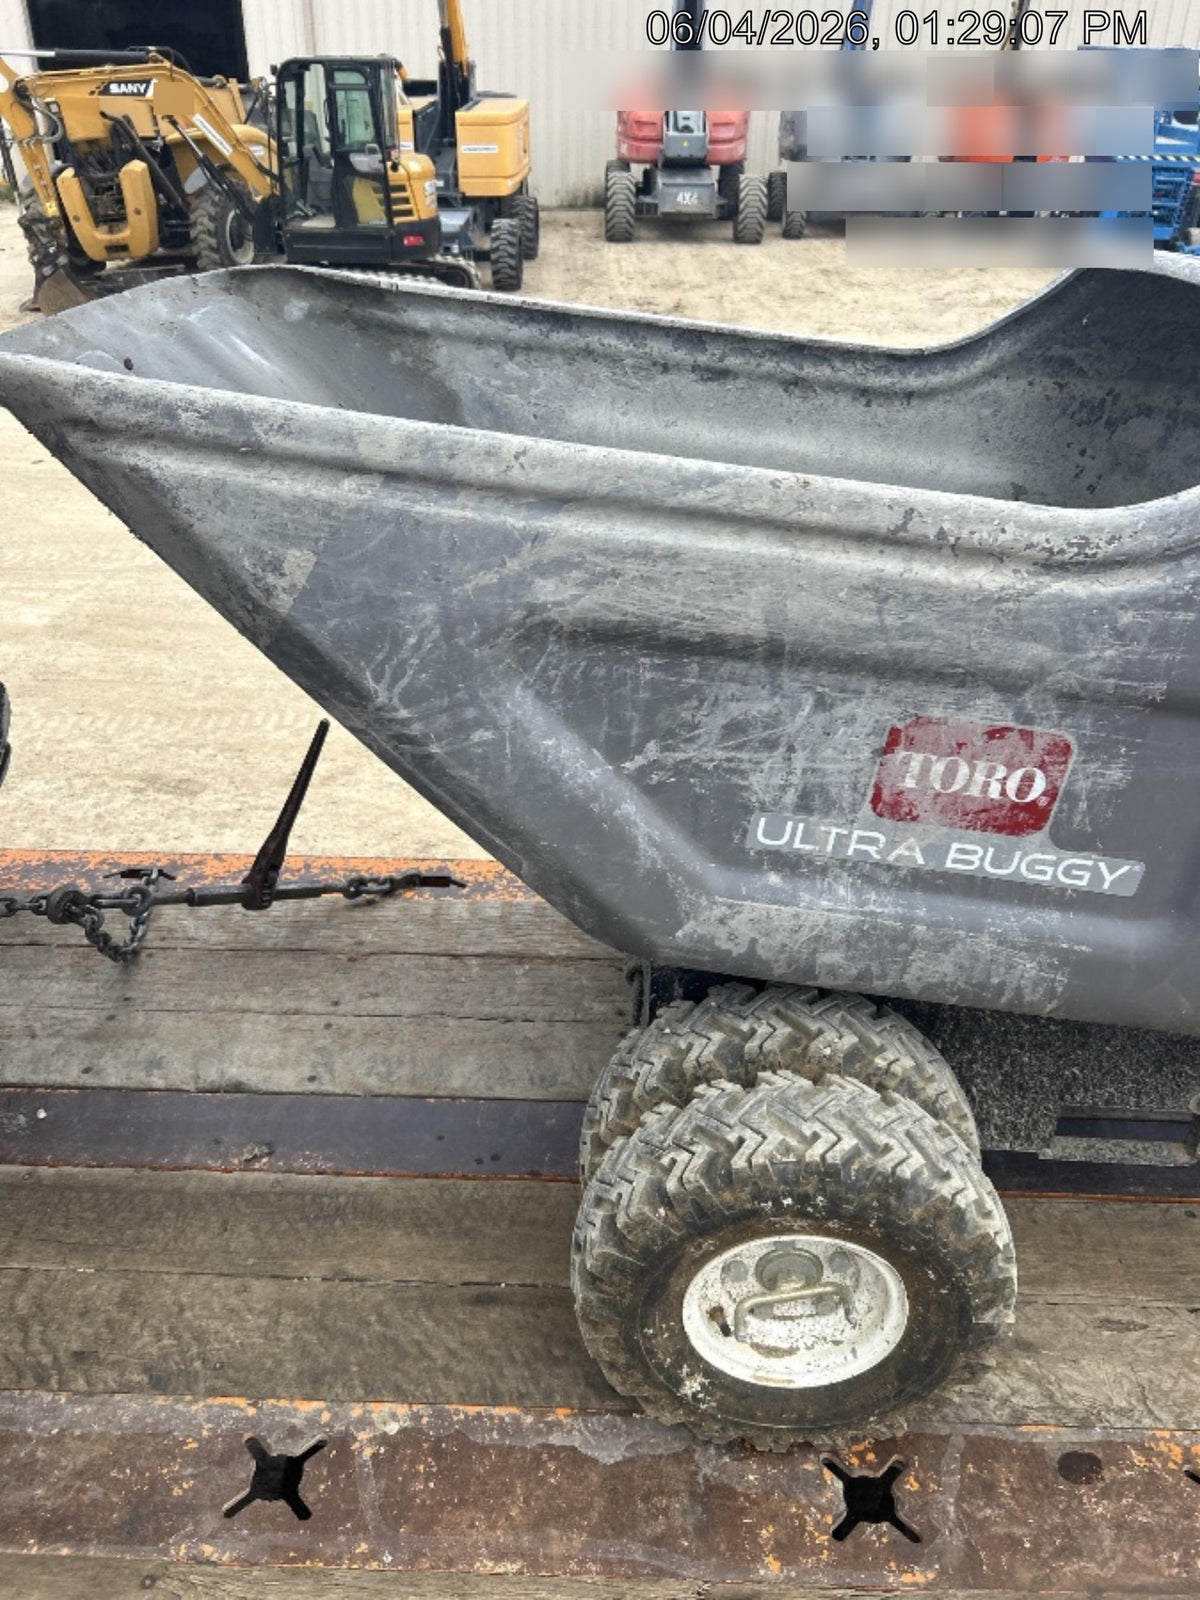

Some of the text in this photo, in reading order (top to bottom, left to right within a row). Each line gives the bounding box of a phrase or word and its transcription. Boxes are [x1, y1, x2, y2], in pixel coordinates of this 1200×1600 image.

[109, 83, 146, 94] SANY
[899, 751, 1047, 804] TORO
[756, 816, 1131, 891] ULTRA BUGGY
